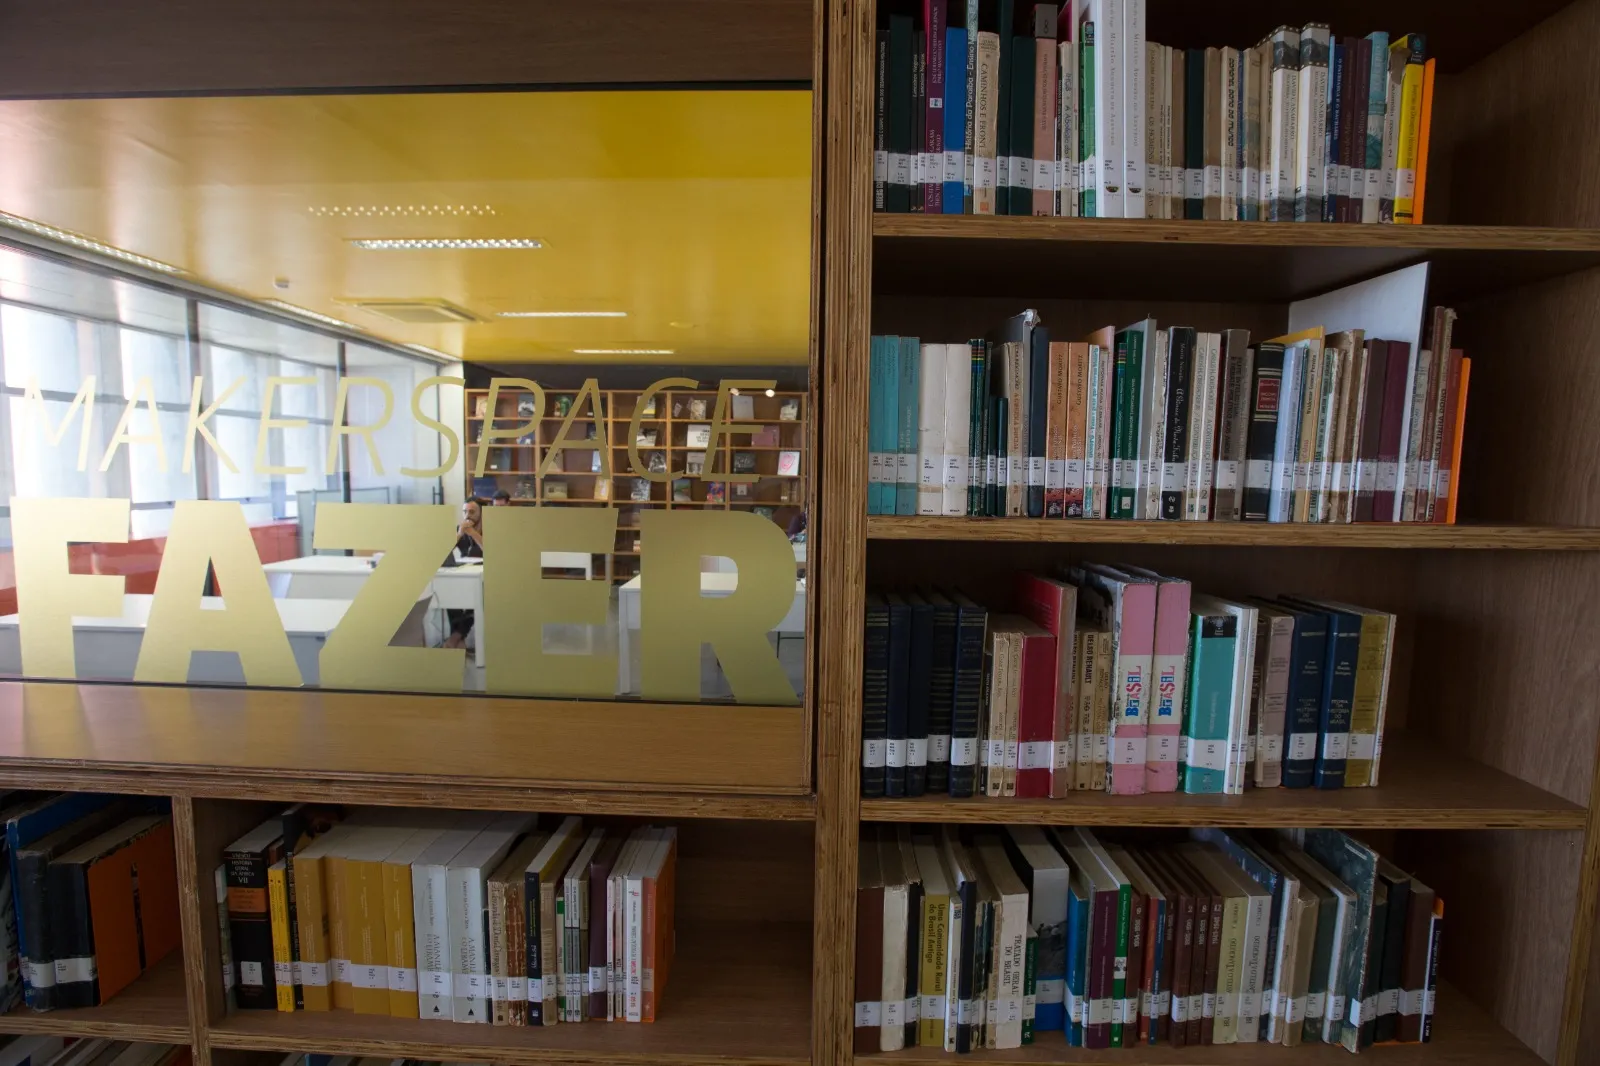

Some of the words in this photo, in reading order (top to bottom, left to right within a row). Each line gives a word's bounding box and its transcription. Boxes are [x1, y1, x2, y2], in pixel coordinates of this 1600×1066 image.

[979, 63, 988, 110] CAMINHOS
[965, 109, 973, 120] da
[965, 122, 973, 149] História
[19, 376, 778, 484] MAKERSPACE
[1436, 417, 1444, 440] TINHA
[10, 496, 801, 704] FAZER
[1085, 656, 1093, 684] RENAULT
[929, 904, 936, 913] do
[925, 939, 936, 963] Antigo
[935, 924, 944, 970] Comunidade
[1005, 946, 1011, 956] DO
[1013, 935, 1022, 967] TRATADO
[1249, 936, 1260, 966] TANCREDO
[935, 972, 943, 991] Rural
